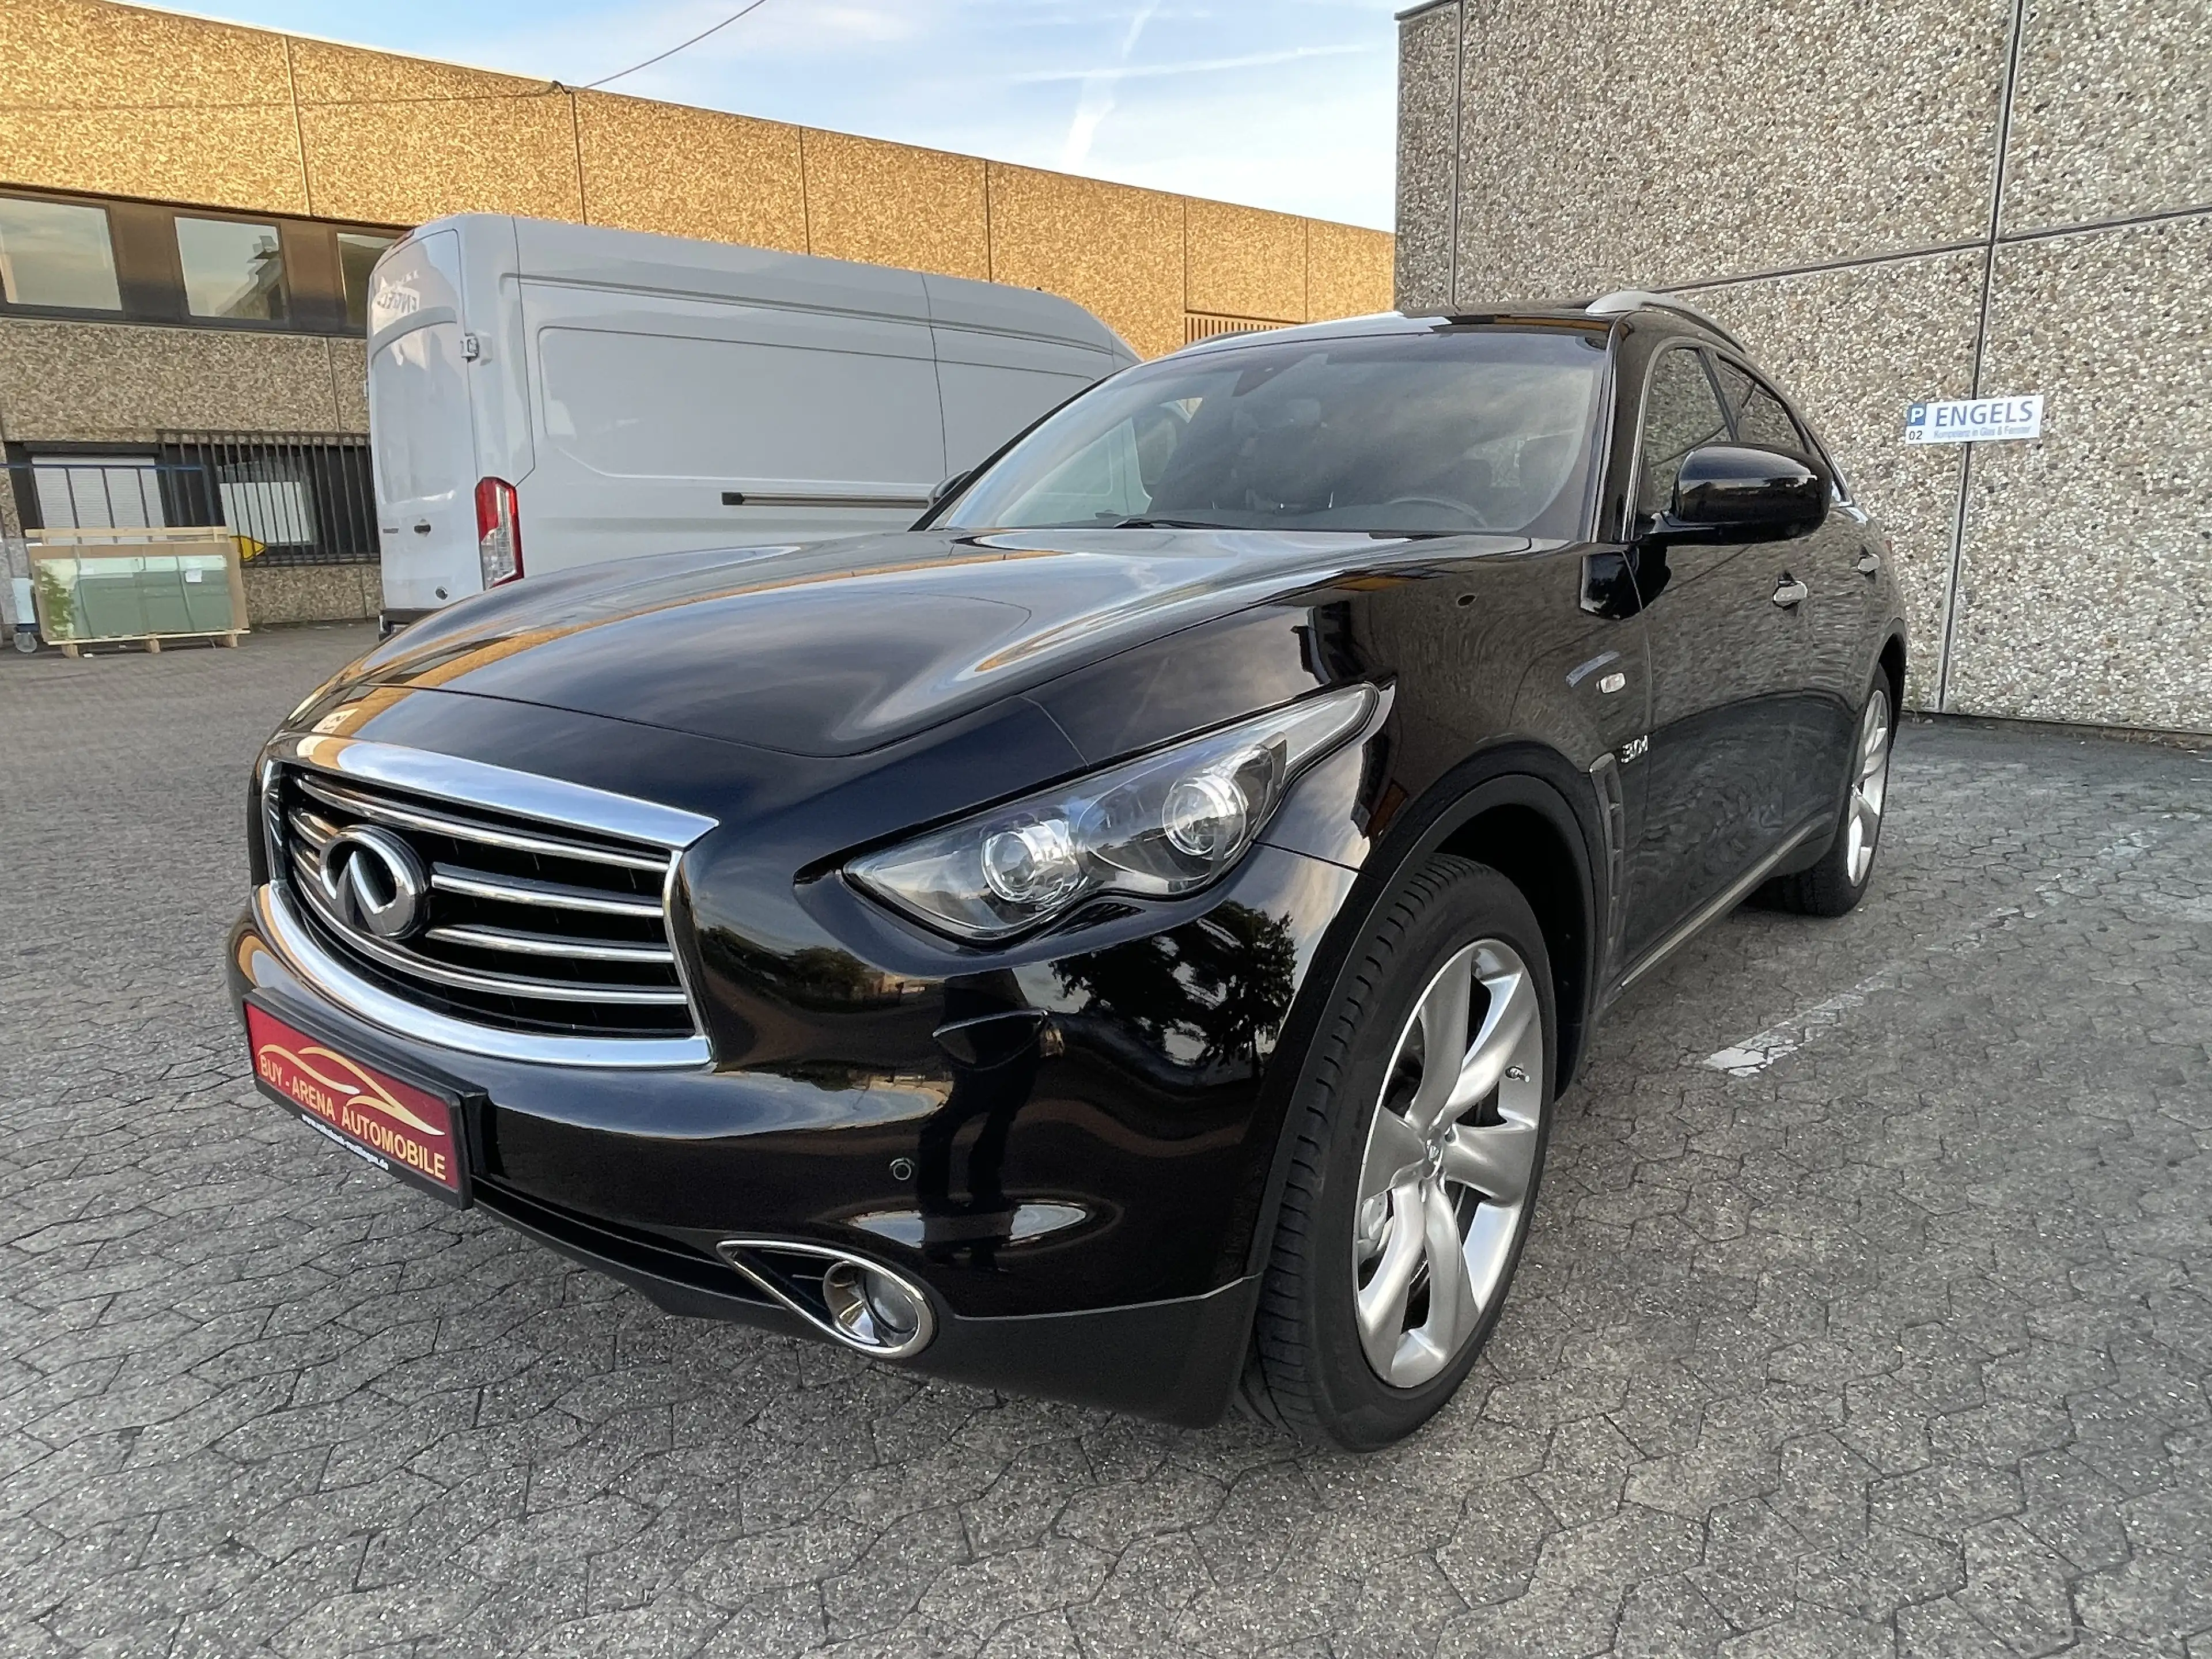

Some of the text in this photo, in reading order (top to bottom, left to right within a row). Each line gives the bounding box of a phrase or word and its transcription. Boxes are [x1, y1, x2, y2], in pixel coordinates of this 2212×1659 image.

[1910, 407, 1924, 423] P
[1936, 400, 2033, 427] ENGELS
[1909, 430, 1922, 440] 02
[260, 1055, 283, 1087] BUY
[291, 1076, 336, 1121] ARENA
[341, 1105, 446, 1180] AUTOMOBILE
